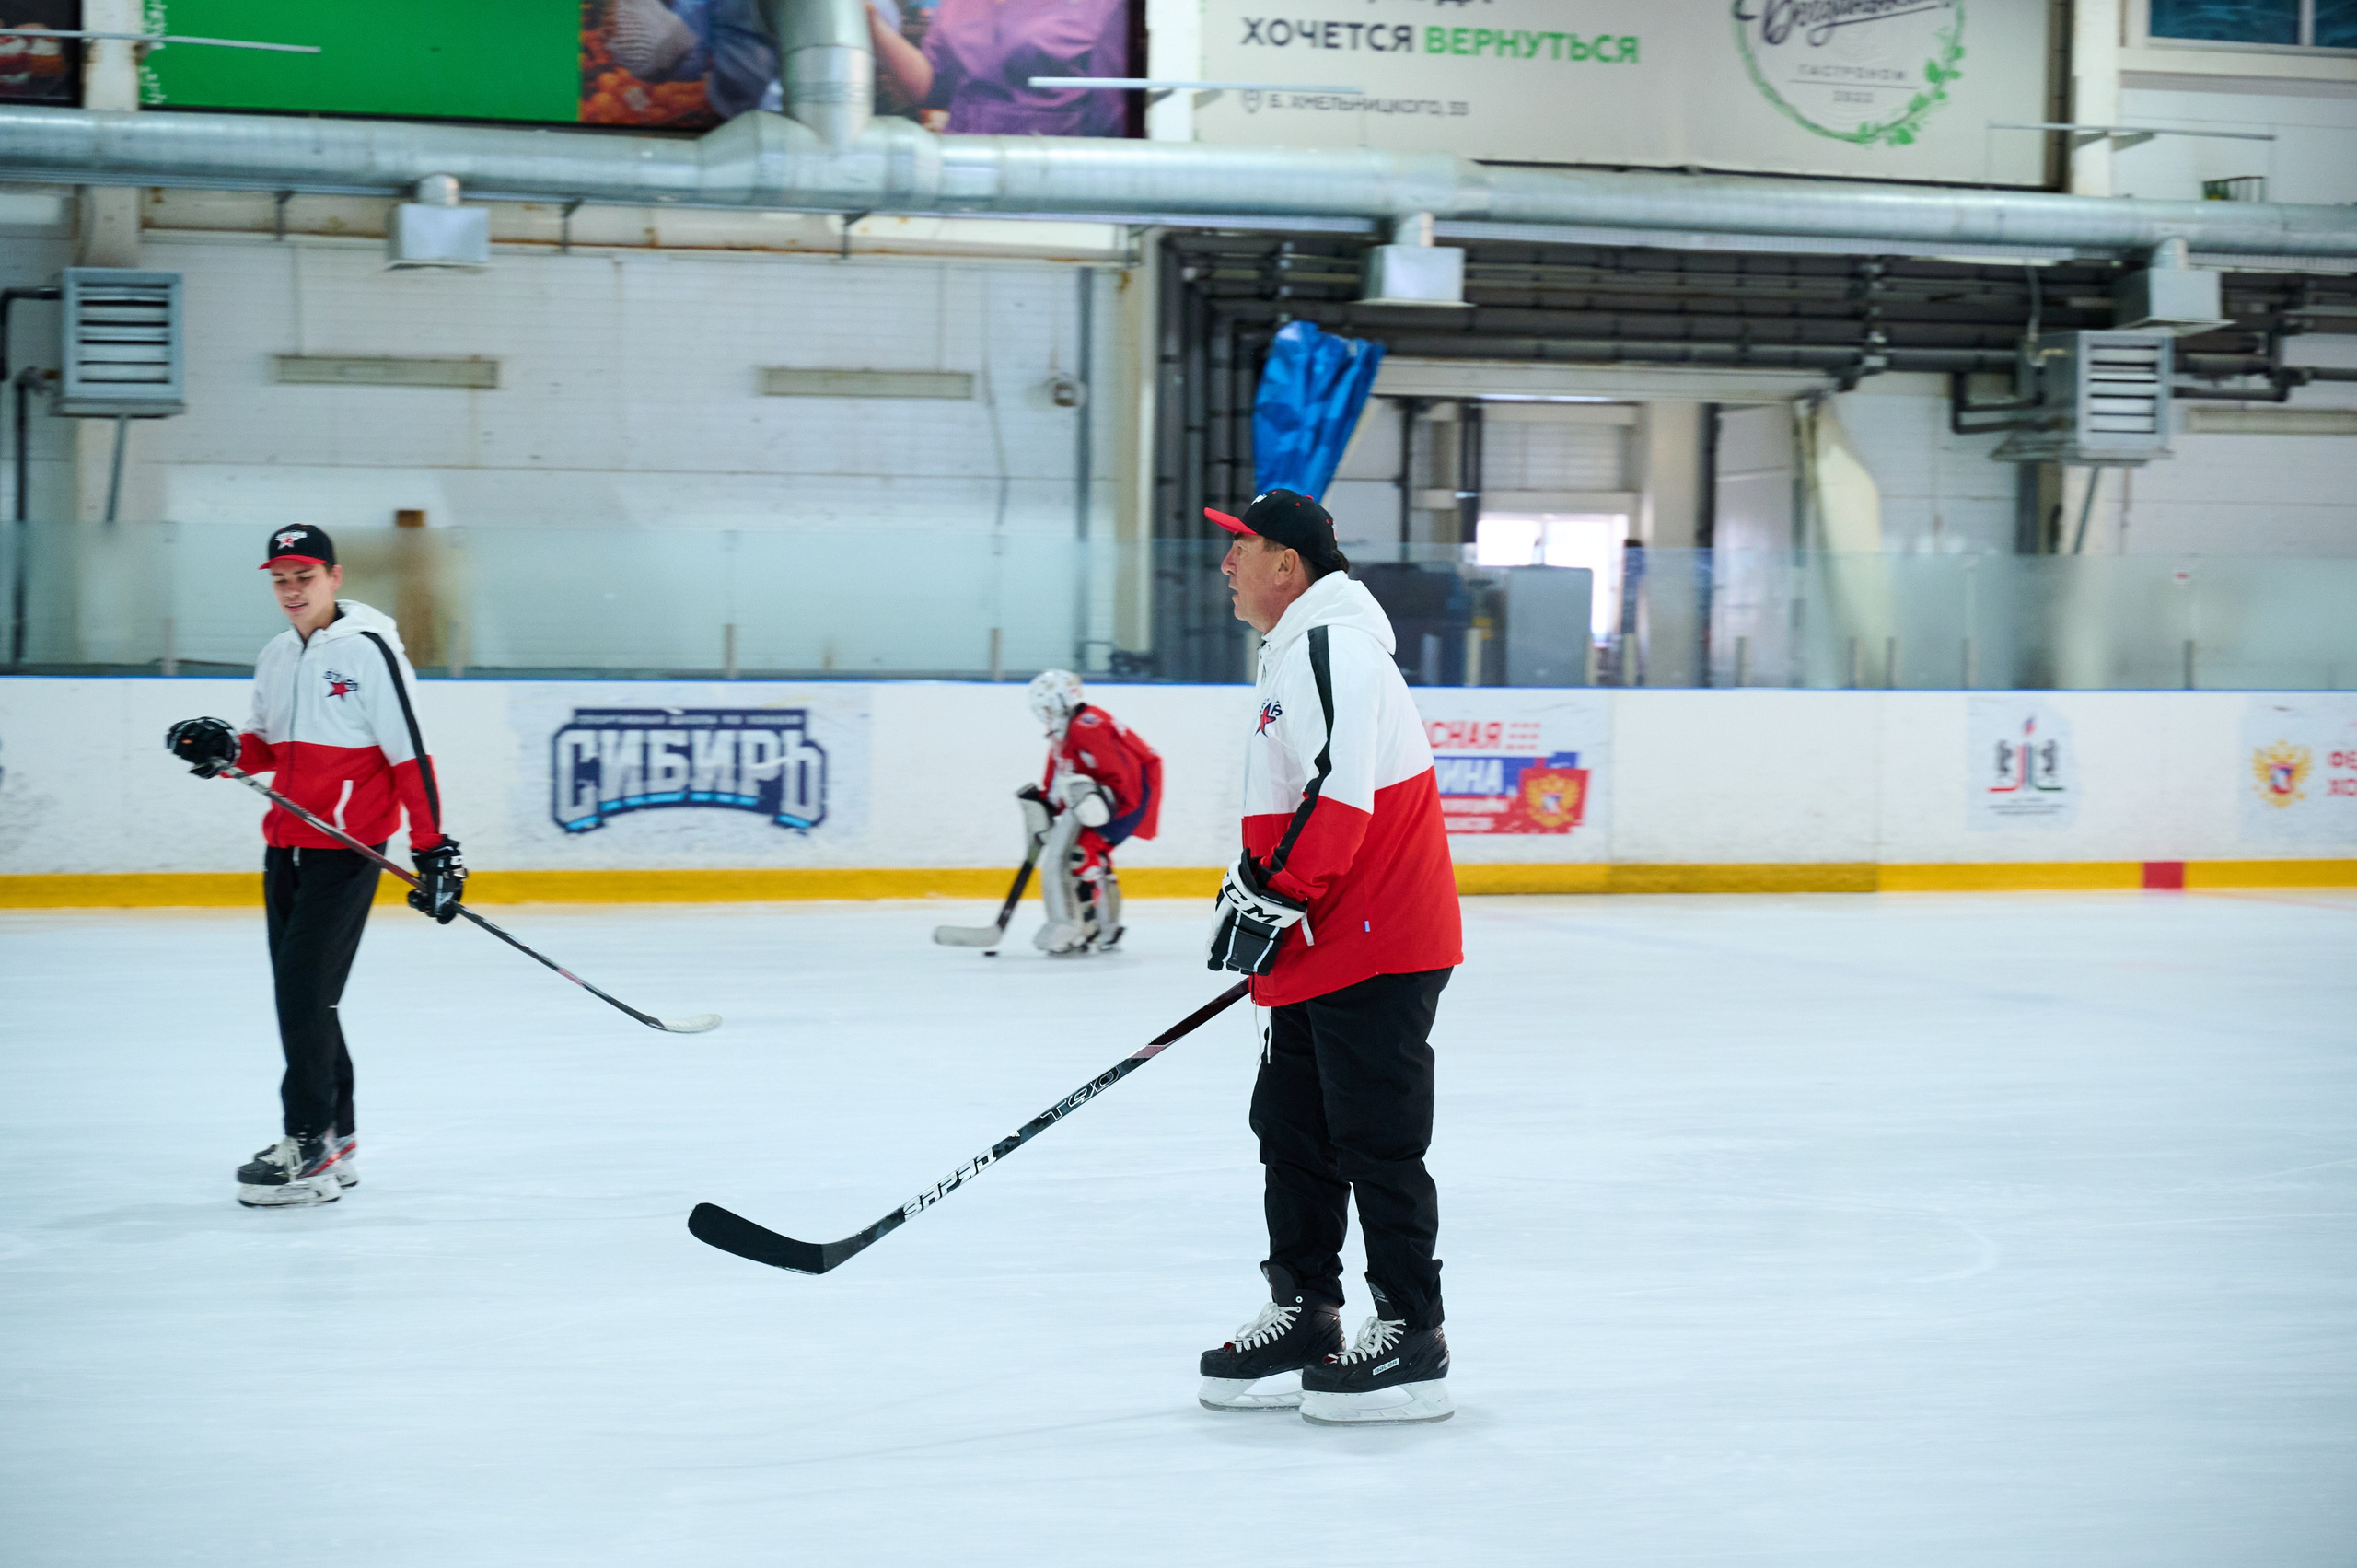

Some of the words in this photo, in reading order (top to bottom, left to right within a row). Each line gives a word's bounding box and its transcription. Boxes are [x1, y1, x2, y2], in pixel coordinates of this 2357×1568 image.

[1240, 17, 1413, 53] ХОЧЕТСЯ
[1424, 25, 1639, 64] ВЕРНУТЬСЯ
[1423, 722, 1502, 749] СНАЯ
[554, 729, 824, 829] СИБИРЬ
[1220, 871, 1283, 924] CM
